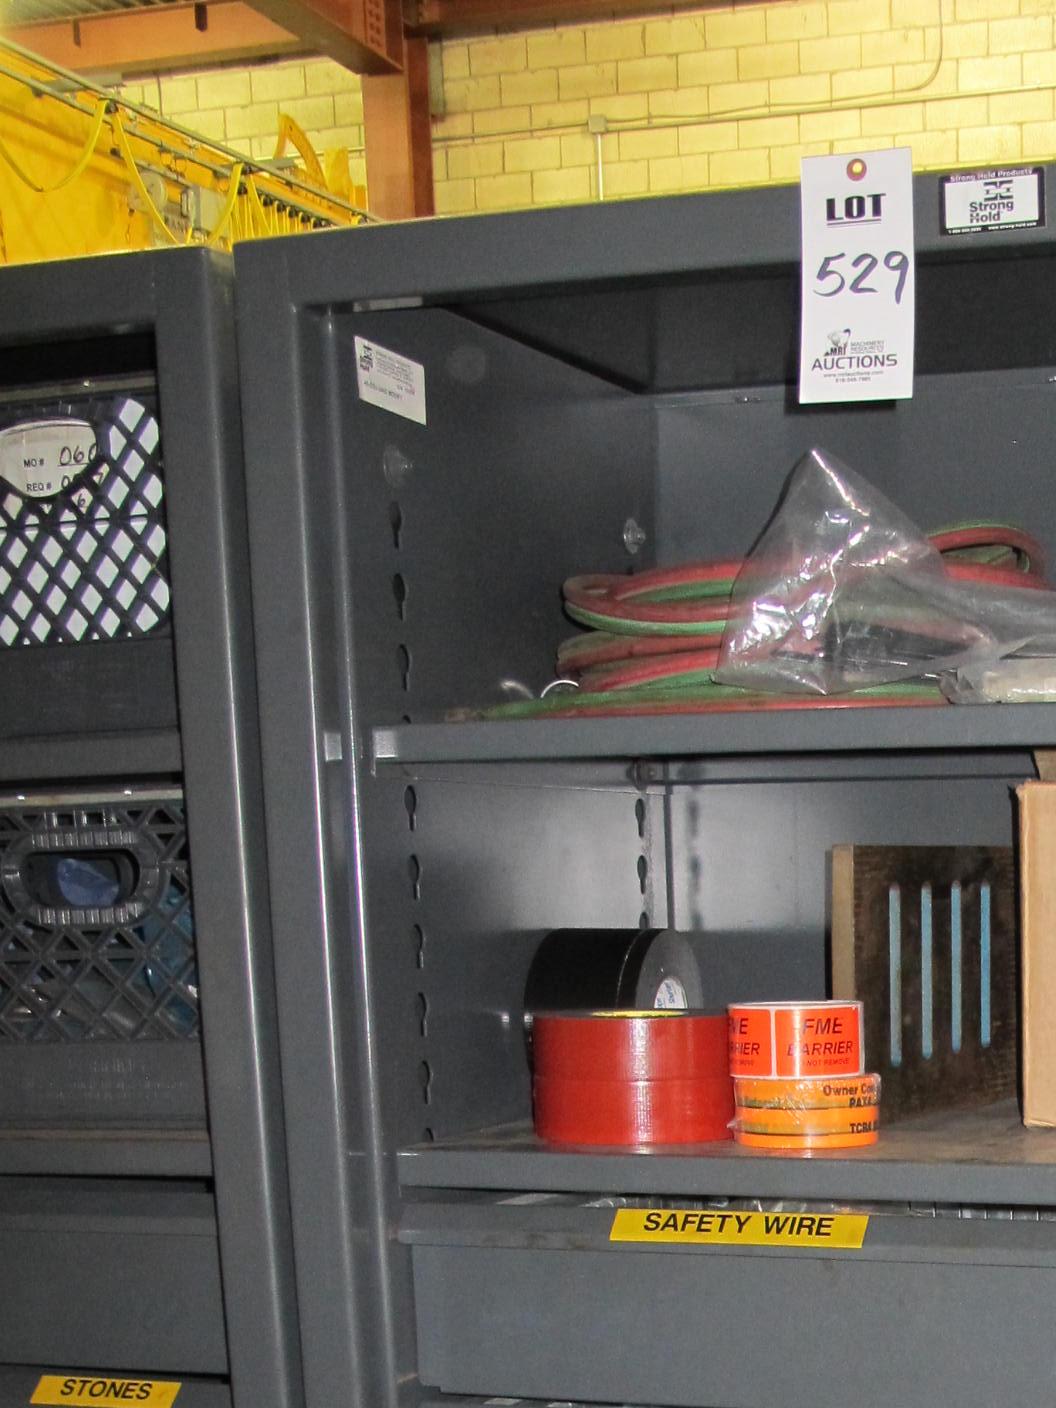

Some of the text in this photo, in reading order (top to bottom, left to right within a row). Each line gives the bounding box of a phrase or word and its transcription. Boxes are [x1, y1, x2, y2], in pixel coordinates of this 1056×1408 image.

[826, 193, 886, 221] LOT
[969, 201, 1014, 212] Strong
[970, 211, 1000, 223] Hold
[813, 250, 909, 304] 529
[811, 353, 897, 371] AUCTIONS
[24, 458, 37, 467] MO
[26, 482, 45, 492] REQ
[803, 1016, 843, 1035] FME
[787, 1040, 853, 1057] BARRIER
[822, 1084, 858, 1097] Owner
[643, 1212, 834, 1236] SAFETY WIRE
[60, 1378, 152, 1400] STONES
